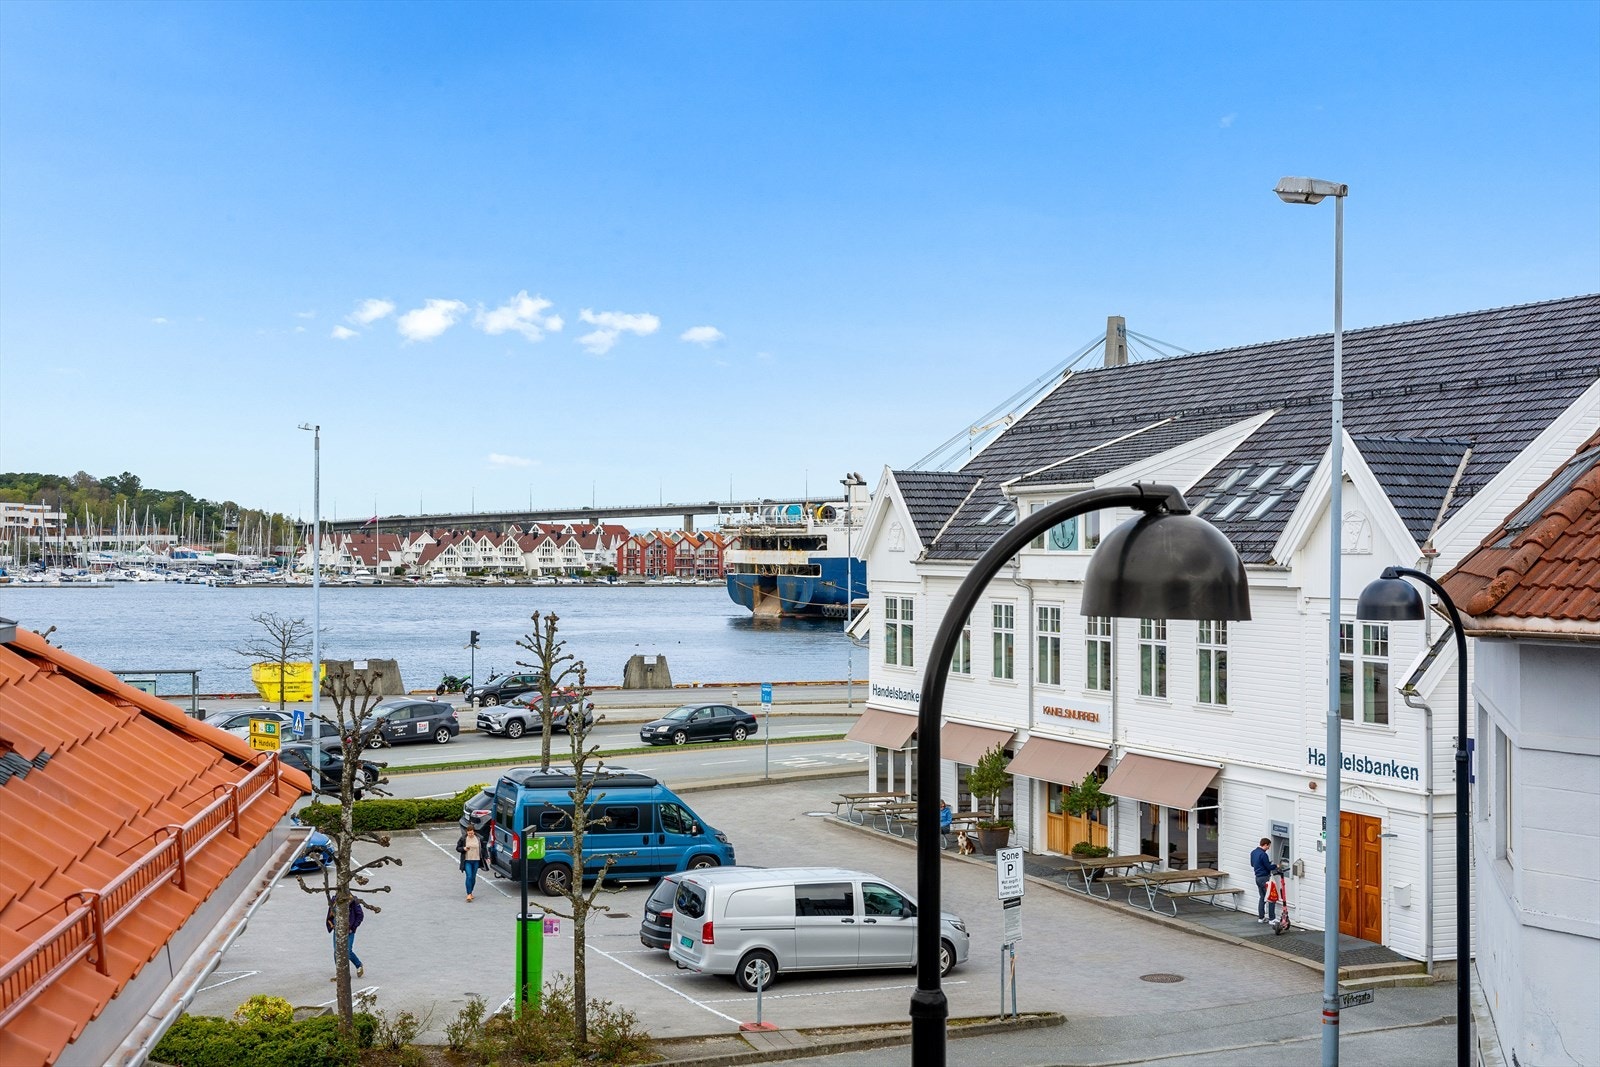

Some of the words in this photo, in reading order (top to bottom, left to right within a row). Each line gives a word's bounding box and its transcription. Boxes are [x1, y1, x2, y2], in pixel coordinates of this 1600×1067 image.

[872, 683, 922, 702] Handelsbanke
[1042, 706, 1099, 722] KANELSNURREN
[1308, 748, 1419, 780] Haelsbanken
[1002, 852, 1019, 861] Sone
[1007, 864, 1014, 876] P
